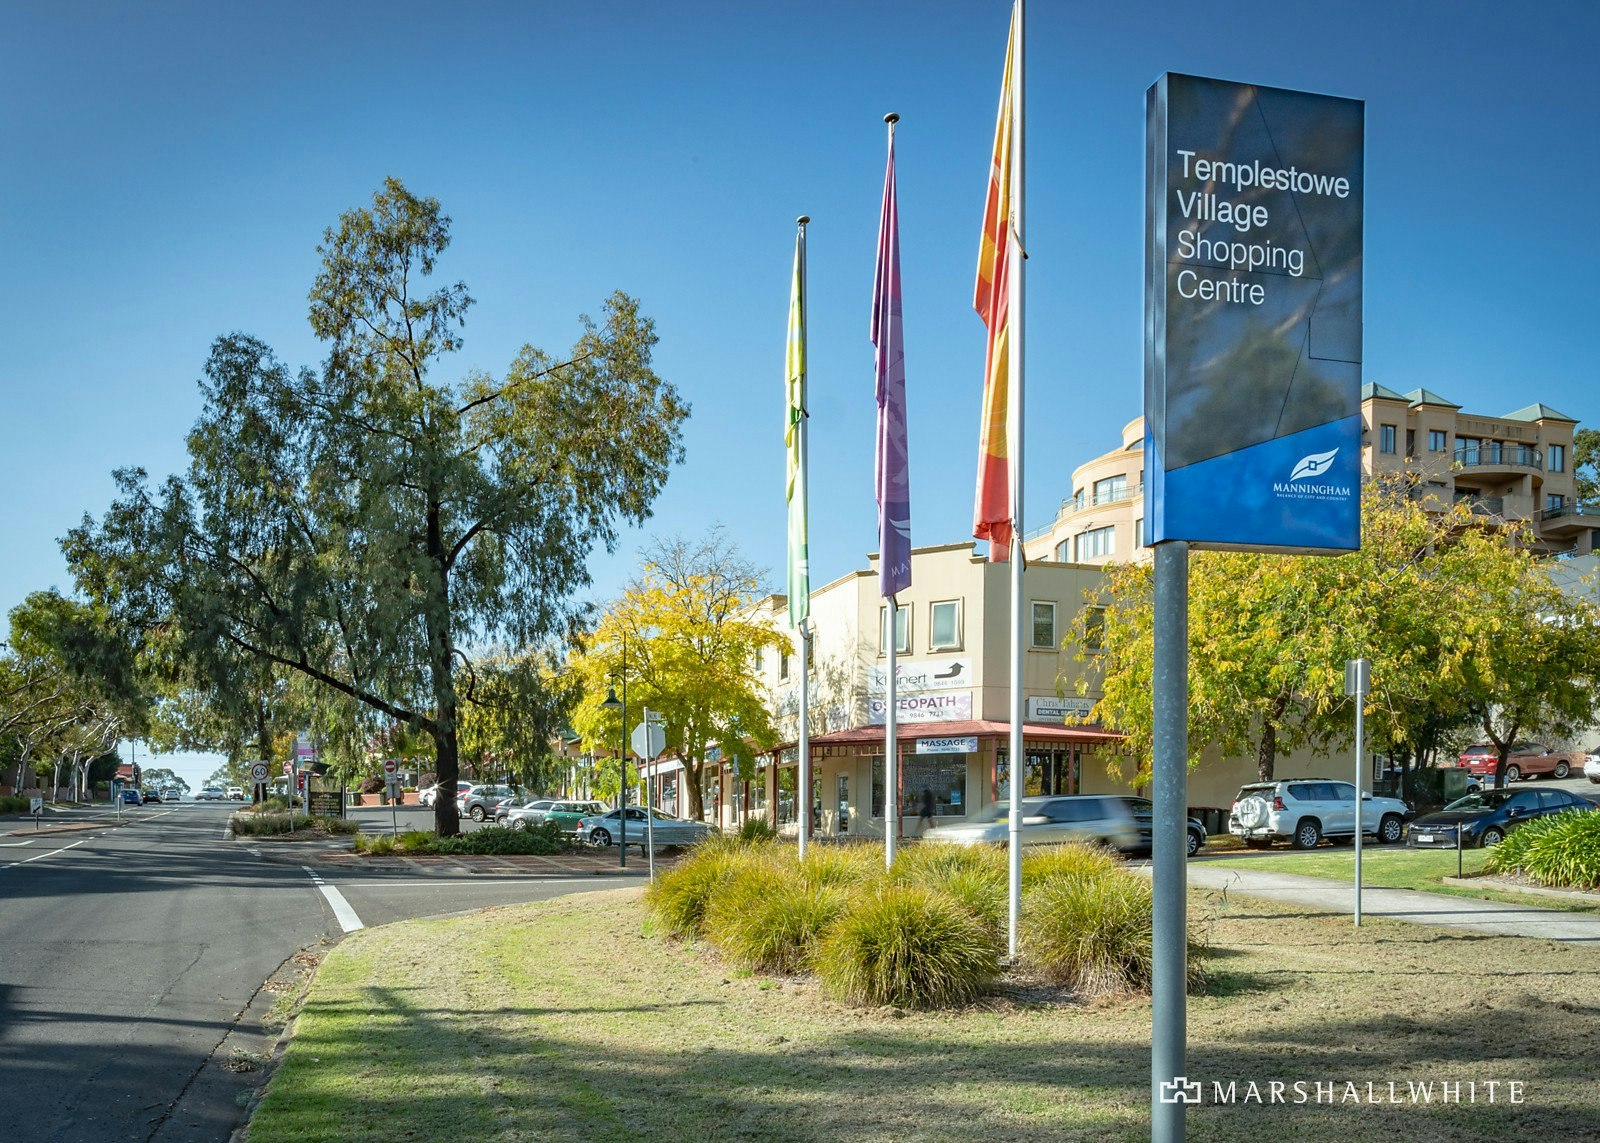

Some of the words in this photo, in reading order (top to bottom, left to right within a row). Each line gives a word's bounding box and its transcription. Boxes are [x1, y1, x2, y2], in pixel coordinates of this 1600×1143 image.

[1176, 149, 1350, 199] Templestowe
[1176, 189, 1269, 232] Village
[1177, 230, 1304, 277] Shopping
[1177, 270, 1265, 305] Centre
[1273, 483, 1350, 496] MANNINGHAM
[875, 673, 928, 687] Klinert
[921, 738, 966, 747] MASSAGE
[255, 768, 265, 776] 60
